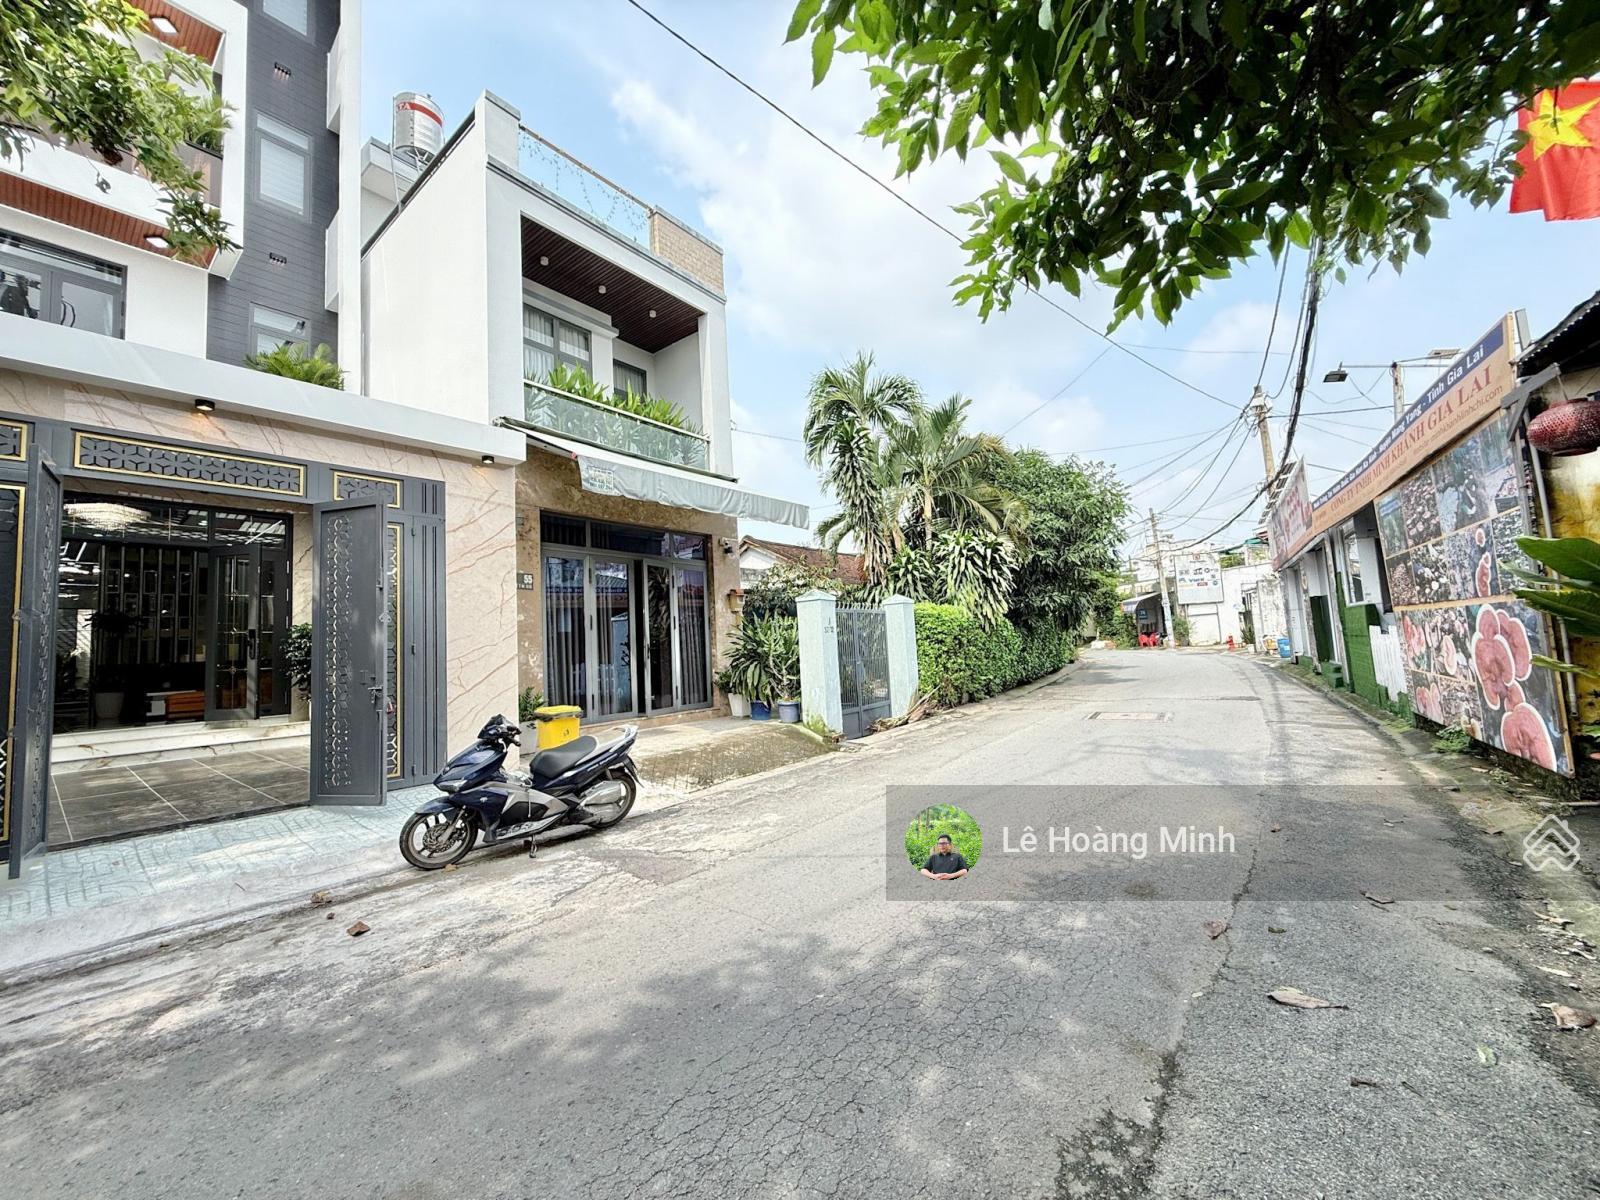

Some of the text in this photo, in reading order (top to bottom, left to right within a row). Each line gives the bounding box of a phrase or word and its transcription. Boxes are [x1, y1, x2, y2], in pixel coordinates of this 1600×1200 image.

[1405, 403, 1422, 424] Yang
[1446, 366, 1464, 386] Gia
[1466, 344, 1484, 369] Lai
[1427, 399, 1454, 431] GIA
[1456, 363, 1493, 406] LAI
